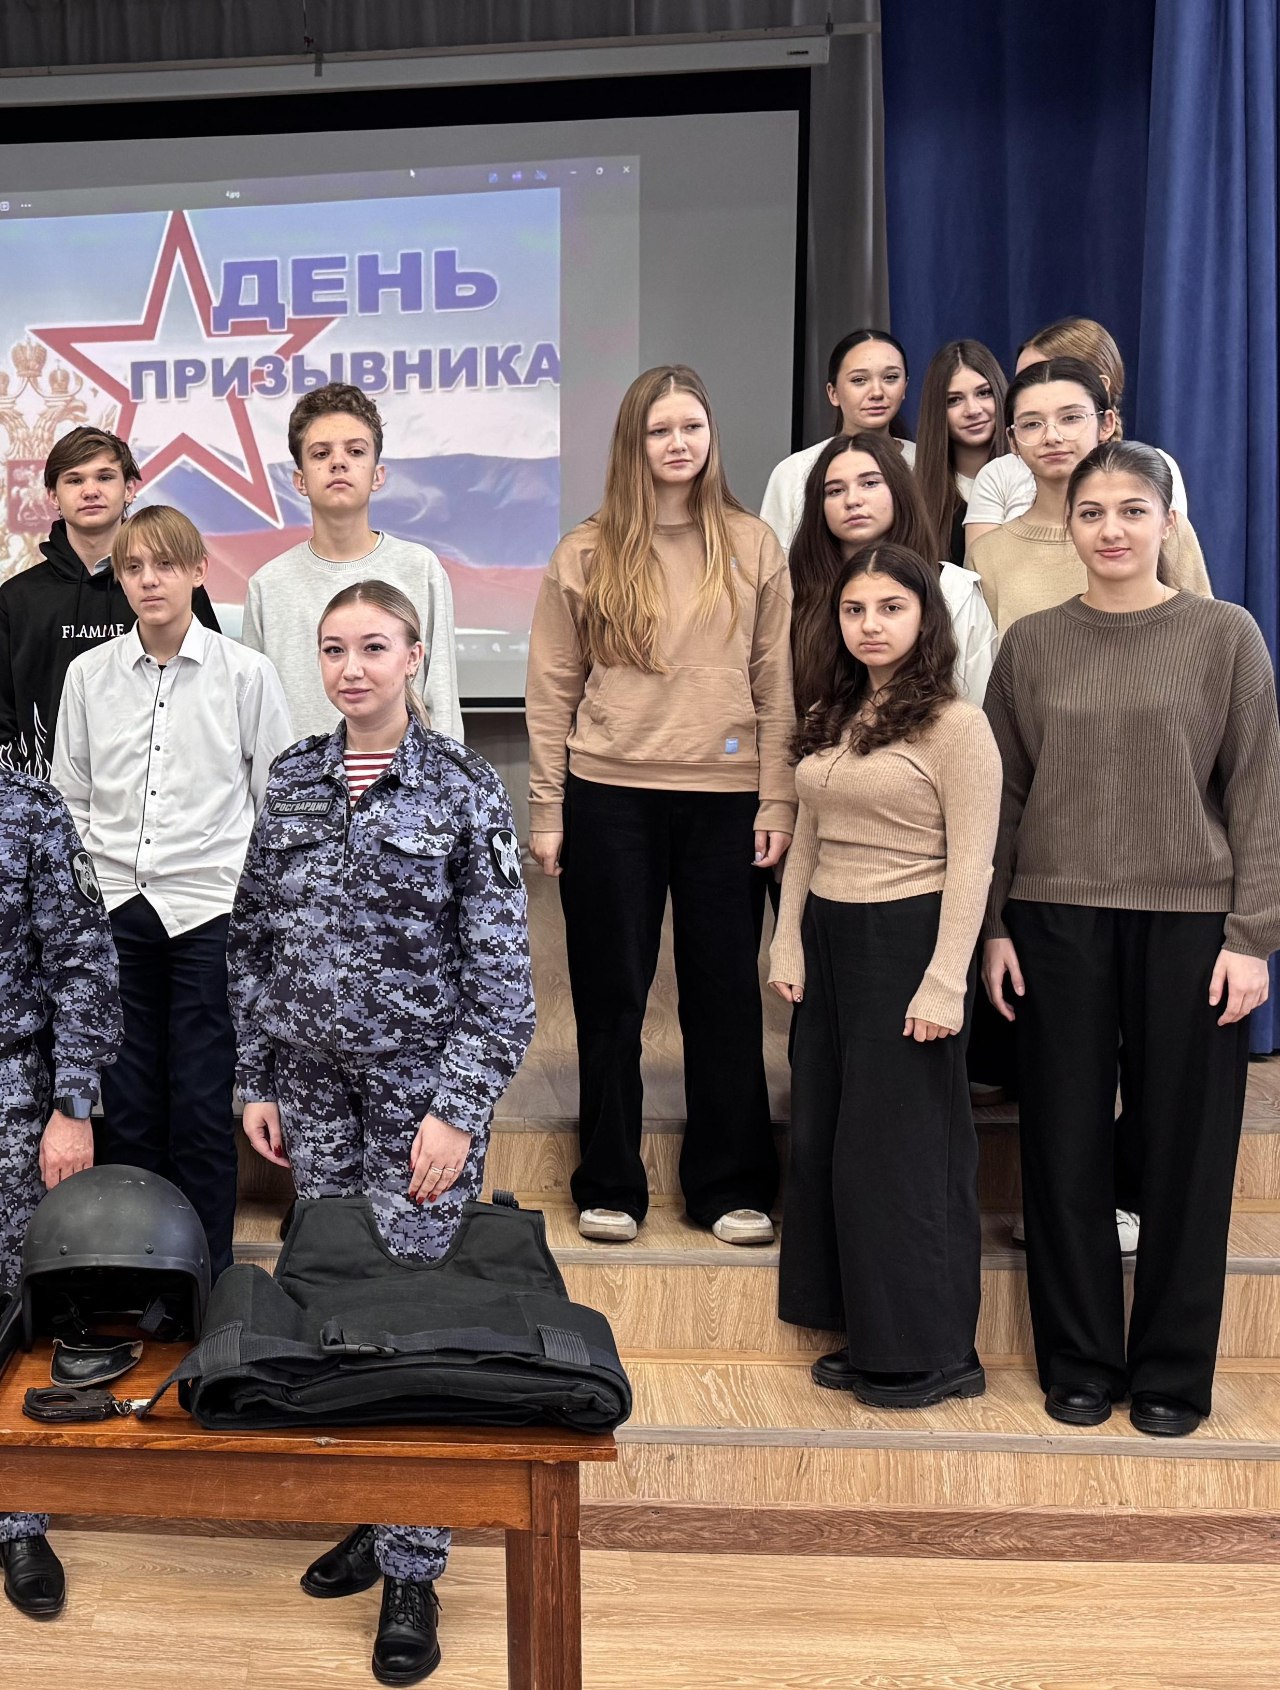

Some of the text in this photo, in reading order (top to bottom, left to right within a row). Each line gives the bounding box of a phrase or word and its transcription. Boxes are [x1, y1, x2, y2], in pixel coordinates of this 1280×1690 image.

[210, 248, 499, 334] ДЕНЬ
[130, 342, 561, 402] ПРИЗЫВНИКА
[61, 623, 125, 639] FLAMME
[273, 801, 329, 812] РОСГВАРДИЯ
